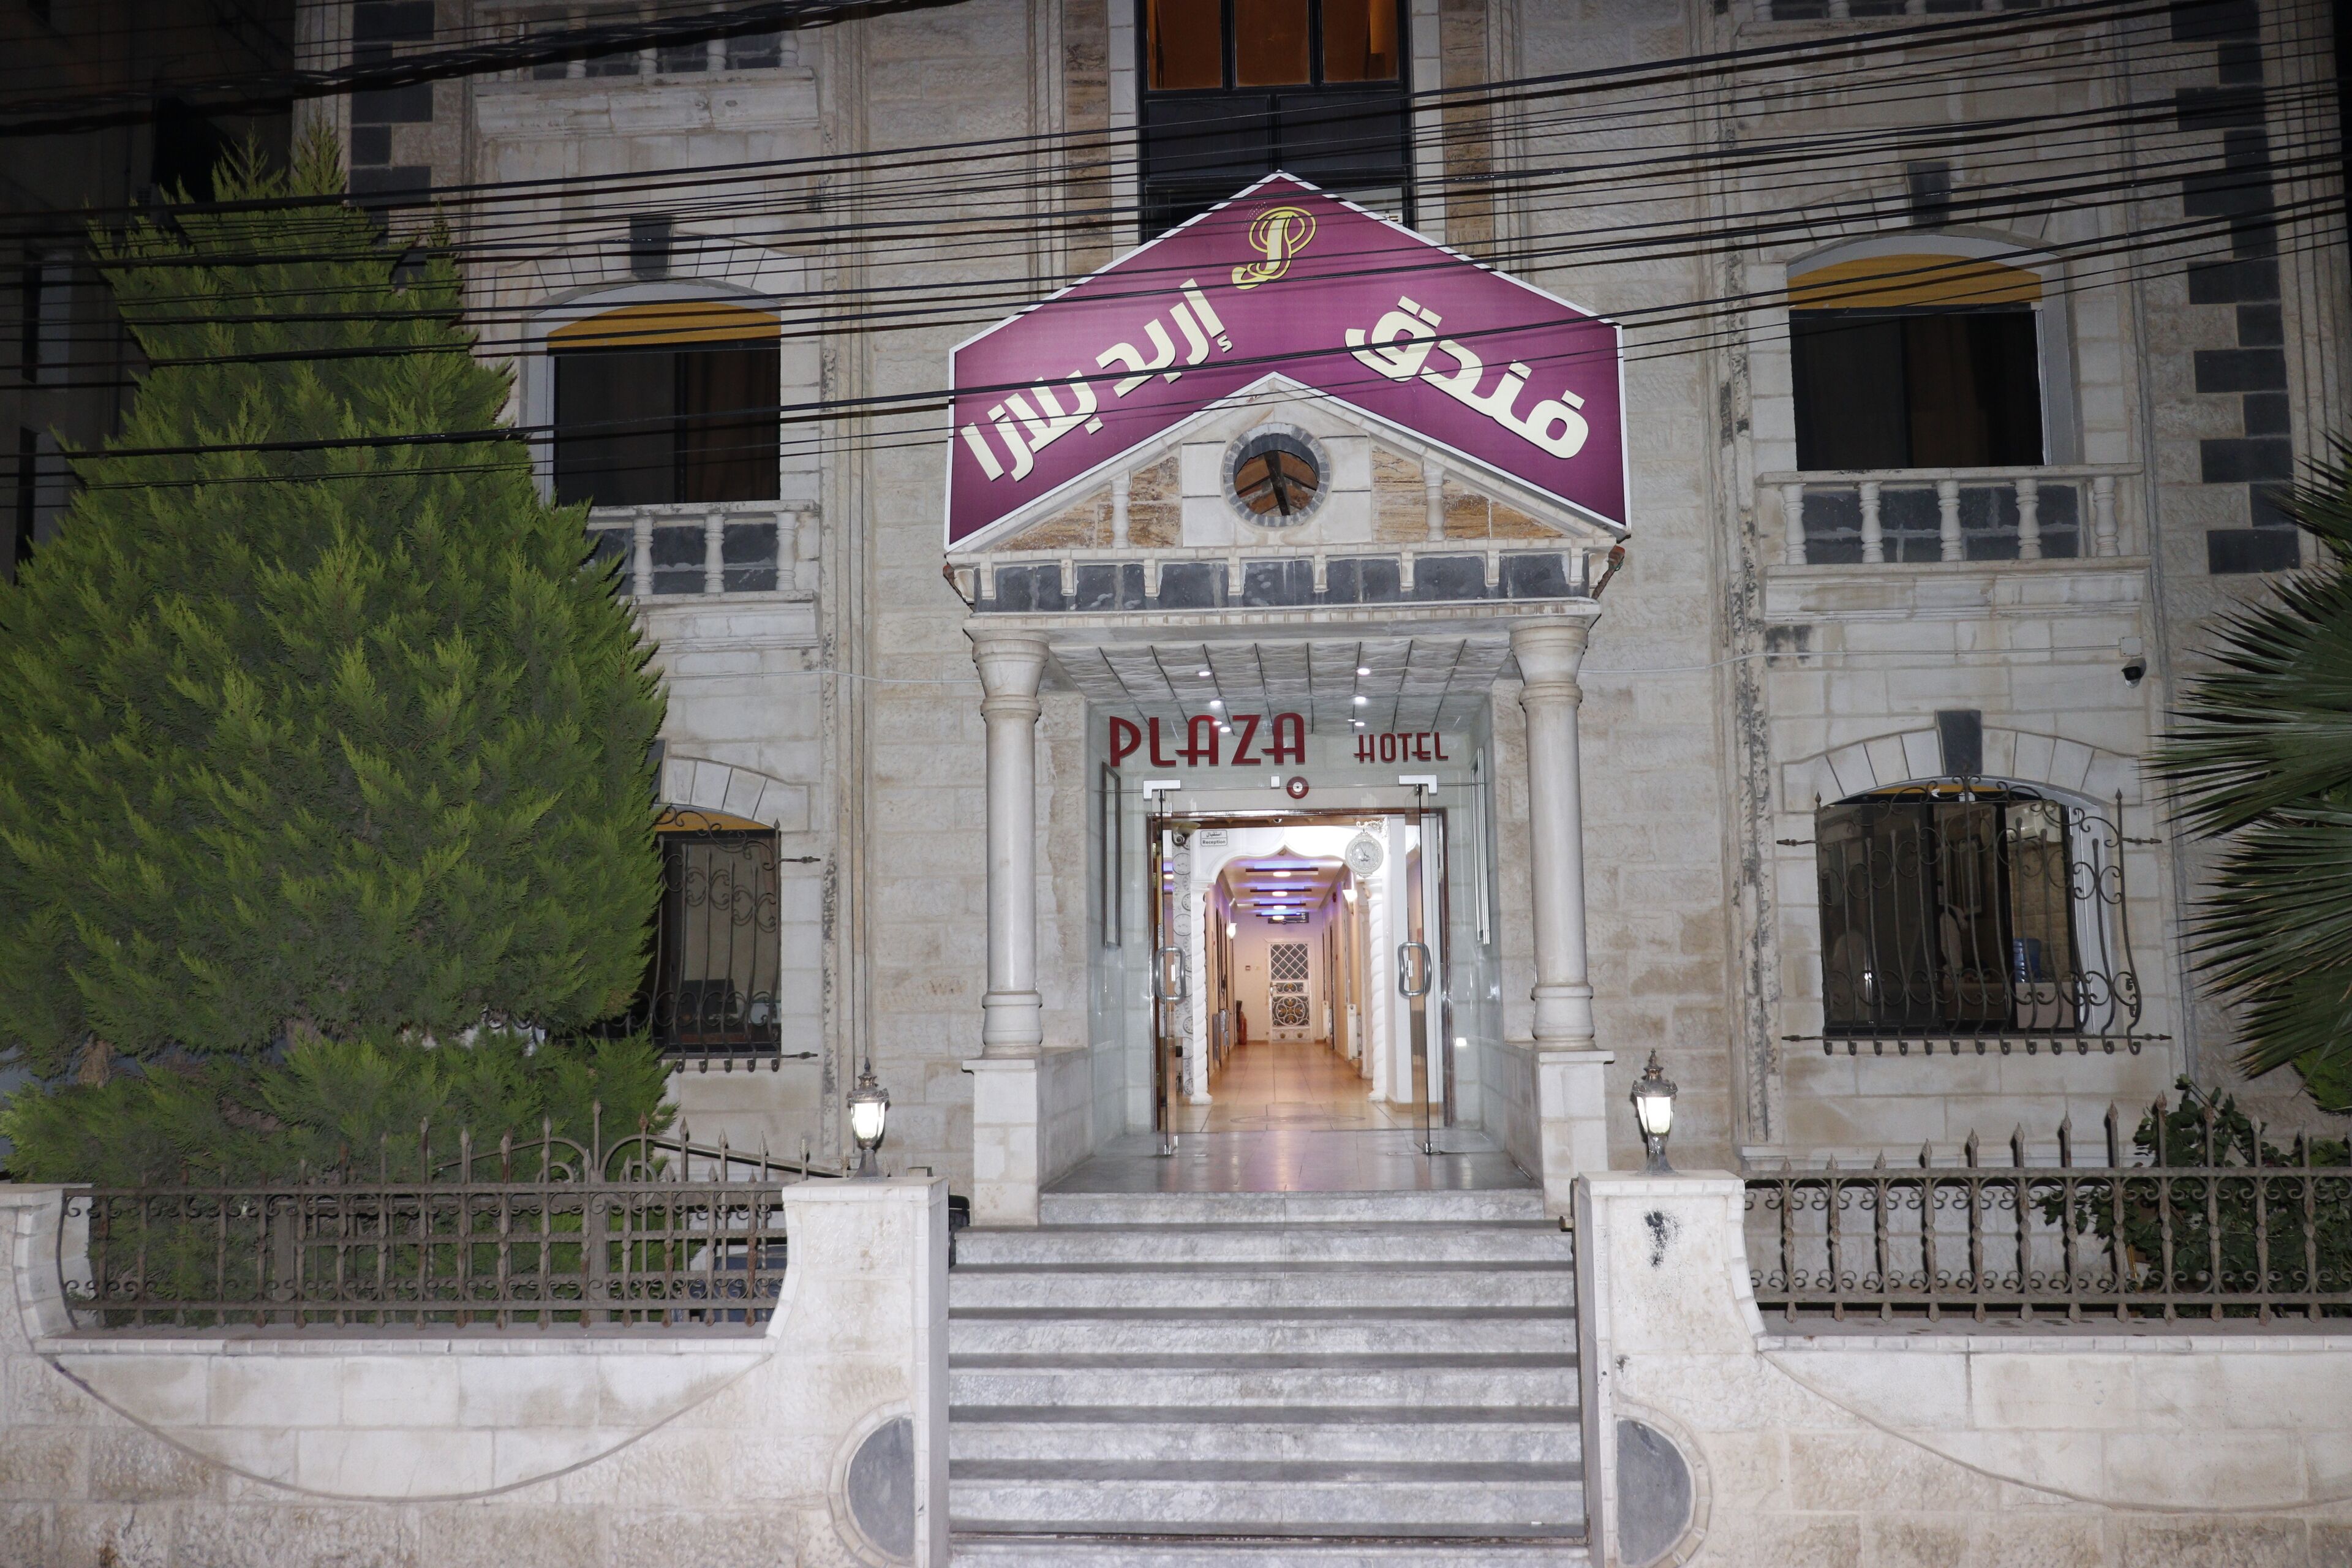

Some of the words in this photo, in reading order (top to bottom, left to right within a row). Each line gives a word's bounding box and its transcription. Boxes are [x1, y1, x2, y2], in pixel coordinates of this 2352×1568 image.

[1095, 278, 1233, 398] إربد
[1344, 295, 1589, 459] فندق
[960, 369, 1104, 482] بلازا
[1109, 712, 1305, 767] PLAZA
[1353, 731, 1449, 763] HOTEL
